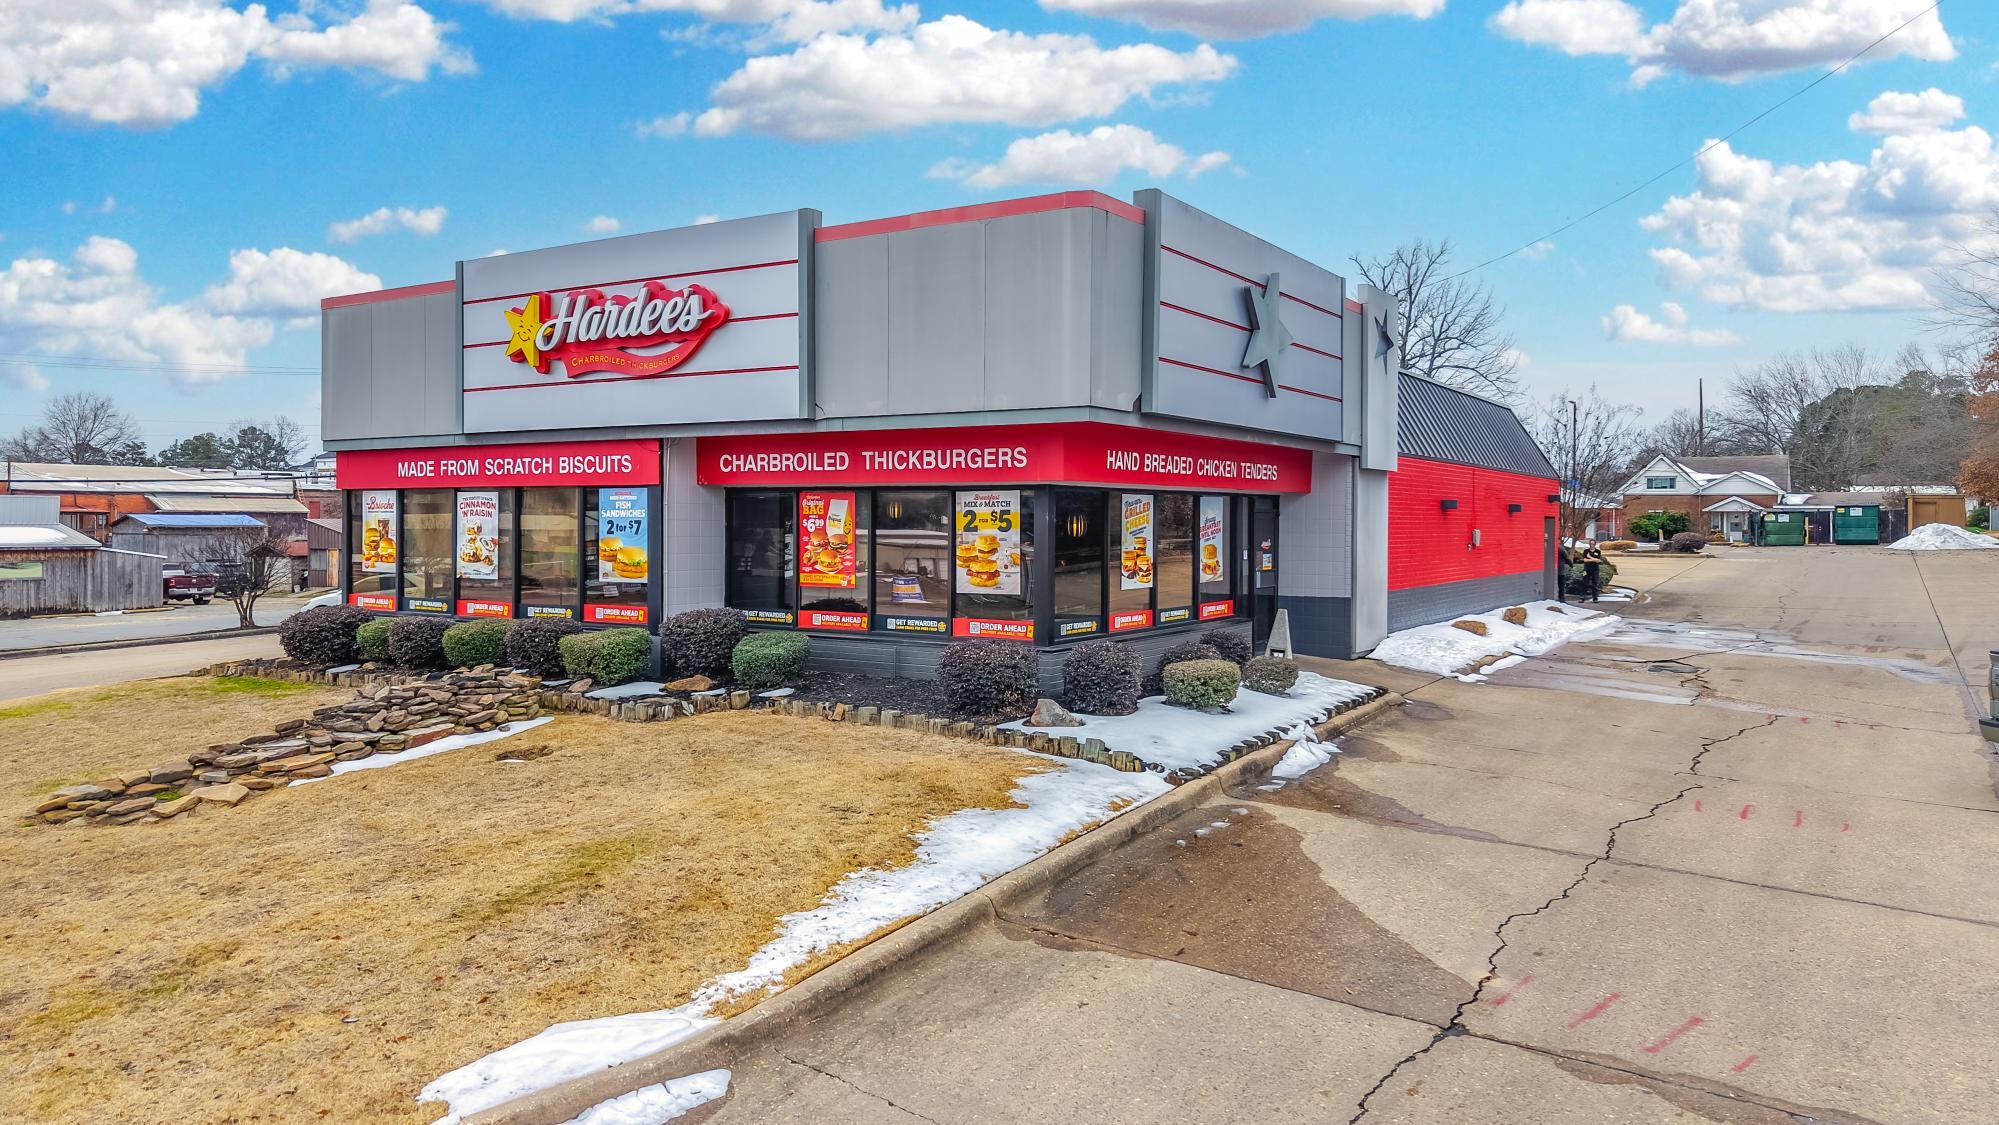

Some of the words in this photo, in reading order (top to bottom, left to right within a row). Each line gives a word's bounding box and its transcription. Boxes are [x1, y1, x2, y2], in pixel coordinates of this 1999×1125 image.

[535, 287, 715, 351] Hardee's
[571, 354, 625, 367] CHARBROILED
[627, 353, 680, 369] THCKBURGERS
[719, 452, 849, 473] CHARBROILED
[862, 447, 1027, 470] THICKBURGERS
[398, 461, 434, 478] MADE
[440, 459, 479, 476] FROM
[485, 457, 552, 475] SCRATCH
[559, 454, 632, 474] BISCUITS
[1107, 450, 1140, 471] HAND
[1144, 453, 1193, 475] BREADED
[1197, 458, 1237, 478] CHICKEN
[1240, 462, 1278, 481] TENDERS
[460, 501, 497, 510] CINNAMON
[615, 501, 632, 510] FISH
[984, 500, 1011, 508] MATCH
[470, 510, 493, 518] RAISIN
[601, 509, 646, 518] SANDWICHES
[803, 505, 824, 515] BAG
[963, 510, 978, 532] 2
[991, 509, 1013, 533] $5
[606, 519, 615, 535] 2
[616, 523, 627, 532] for
[628, 519, 642, 535] $7
[603, 608, 620, 616] ORDER
[759, 611, 786, 619] REWARDED
[821, 614, 840, 622] ORDER
[842, 616, 862, 624] AHEAD
[907, 619, 938, 627] REWARDED
[980, 622, 1003, 631] ORDER
[1004, 624, 1027, 633] AHEAD
